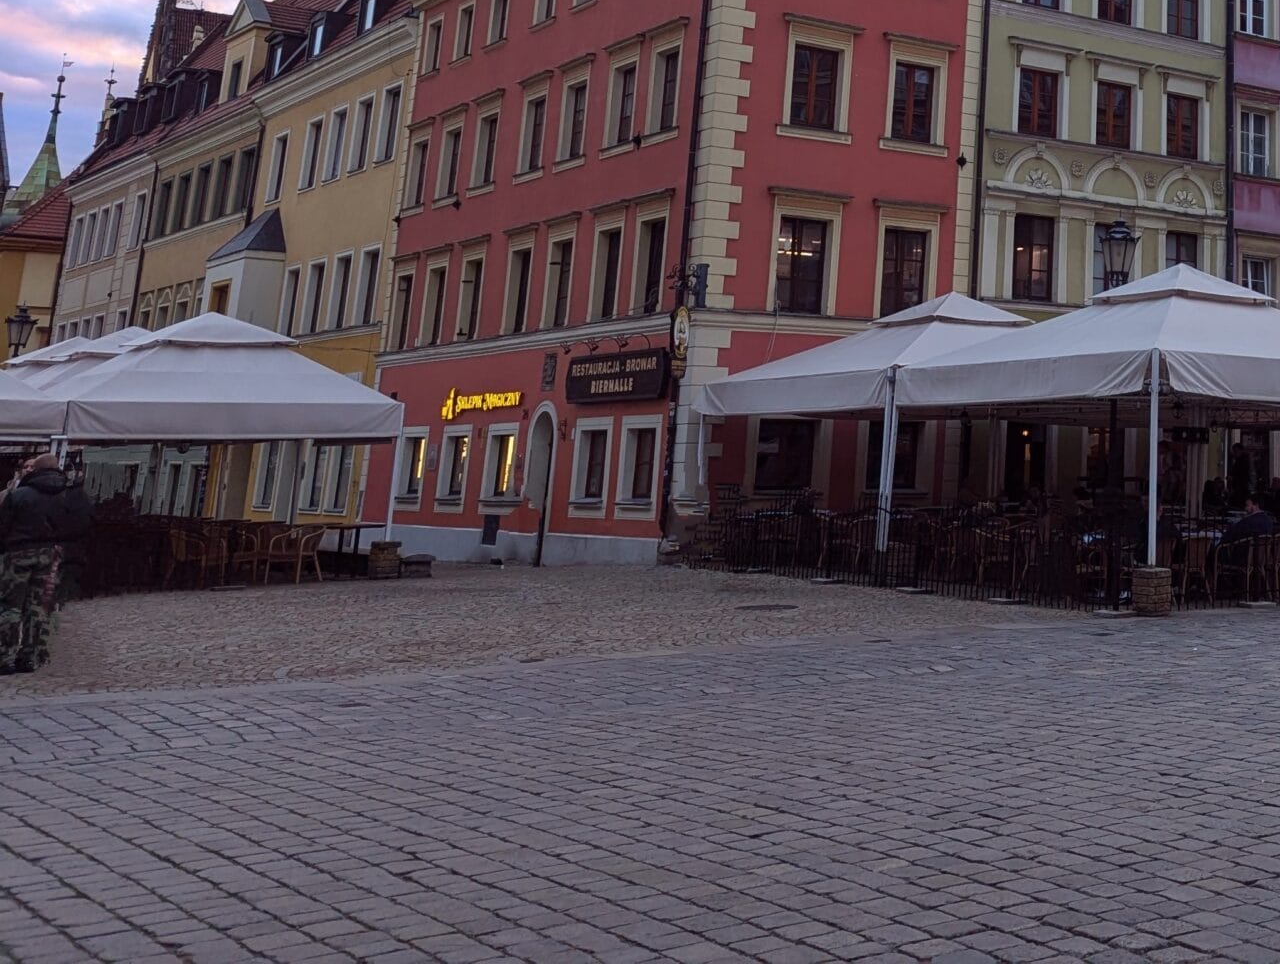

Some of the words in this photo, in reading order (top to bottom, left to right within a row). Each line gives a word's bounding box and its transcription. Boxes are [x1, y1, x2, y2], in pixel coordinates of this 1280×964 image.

[571, 360, 620, 377] RESTAURACJA
[625, 356, 657, 372] BROWAR
[590, 377, 634, 394] BIERHALLE
